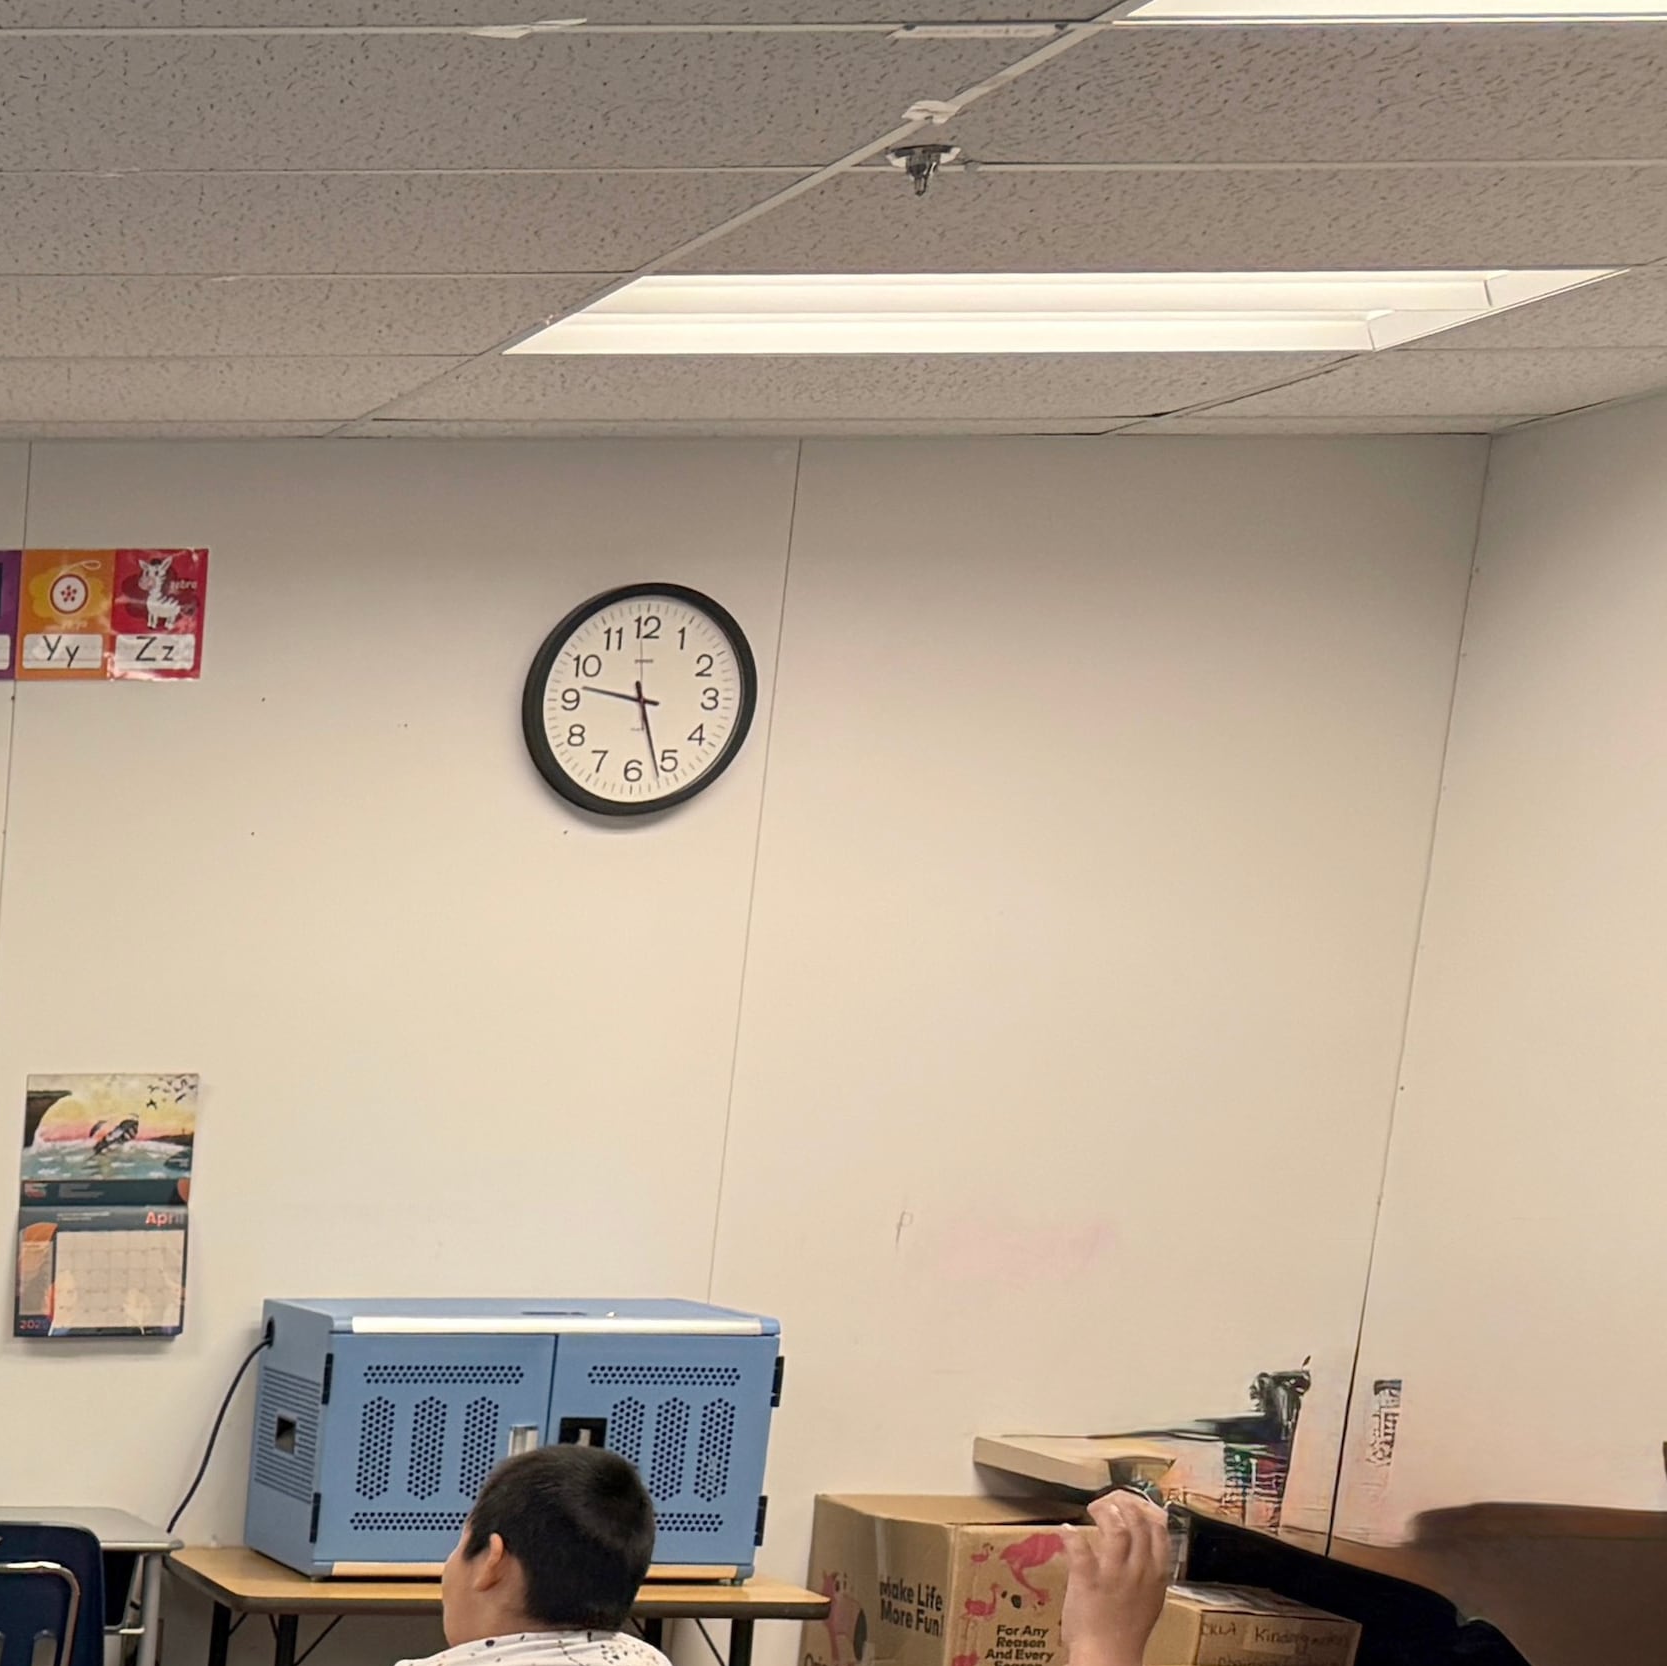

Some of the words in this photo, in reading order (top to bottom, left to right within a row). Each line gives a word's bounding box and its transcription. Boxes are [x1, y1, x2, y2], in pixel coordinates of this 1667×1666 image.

[603, 627, 624, 650] 11
[634, 615, 661, 639] 12
[677, 627, 687, 650] 1
[572, 654, 602, 678] 10
[695, 654, 714, 677] 2
[560, 688, 580, 711] 9
[700, 687, 719, 711] 3
[567, 724, 586, 747] 8
[687, 723, 706, 746] 4
[591, 750, 609, 773] 7
[623, 759, 643, 782] 6
[659, 750, 679, 773] 5
[879, 1579, 914, 1604] Make
[917, 1584, 943, 1611] Life
[880, 1598, 912, 1628] More
[916, 1608, 944, 1637] Fun!
[996, 1637, 1046, 1648] Reason
[997, 1625, 1019, 1635] For
[1022, 1625, 1049, 1638] Any
[985, 1650, 1012, 1660] And
[1015, 1650, 1054, 1662] Every
